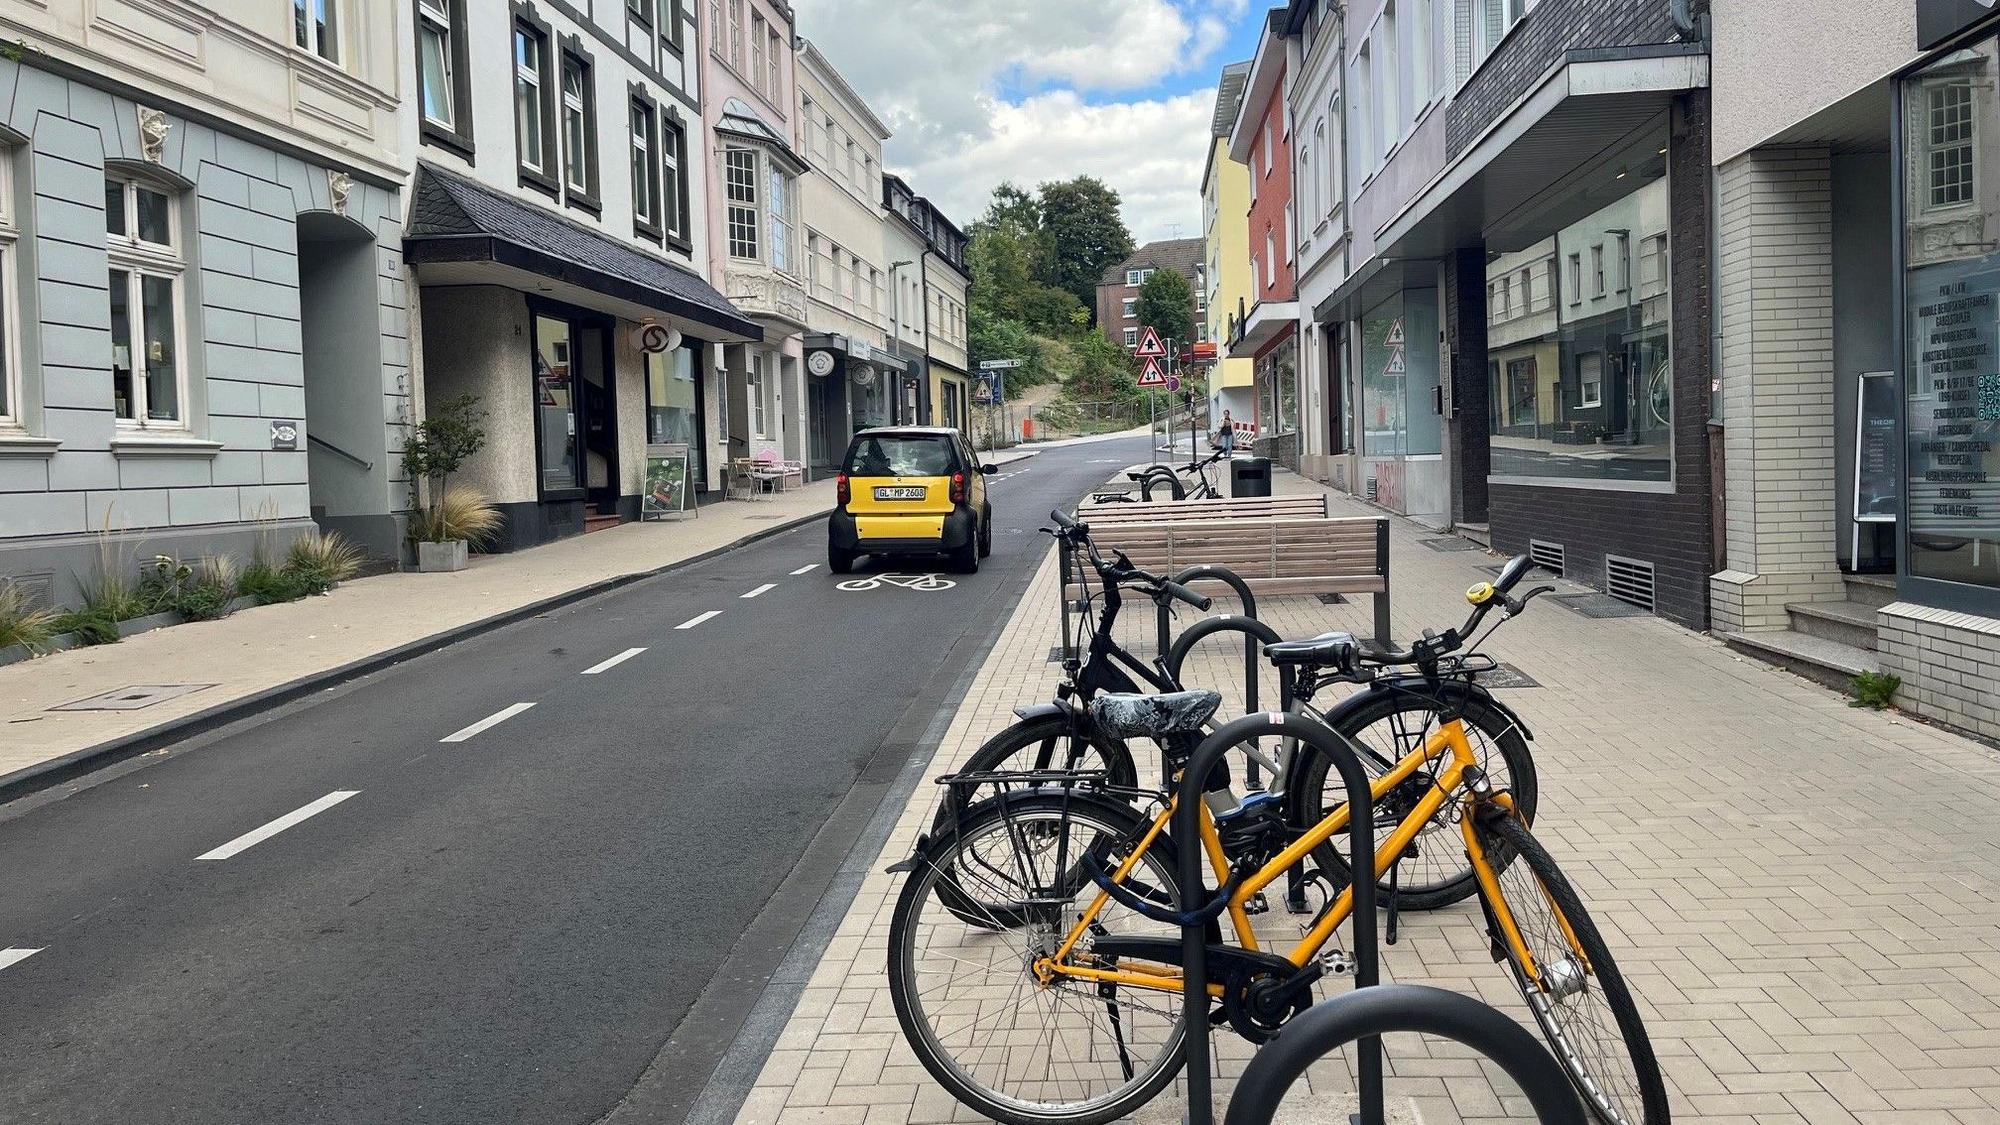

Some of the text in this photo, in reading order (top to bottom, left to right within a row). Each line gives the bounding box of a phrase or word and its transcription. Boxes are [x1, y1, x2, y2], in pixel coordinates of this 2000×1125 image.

[879, 488, 924, 497] GL MP 2608
